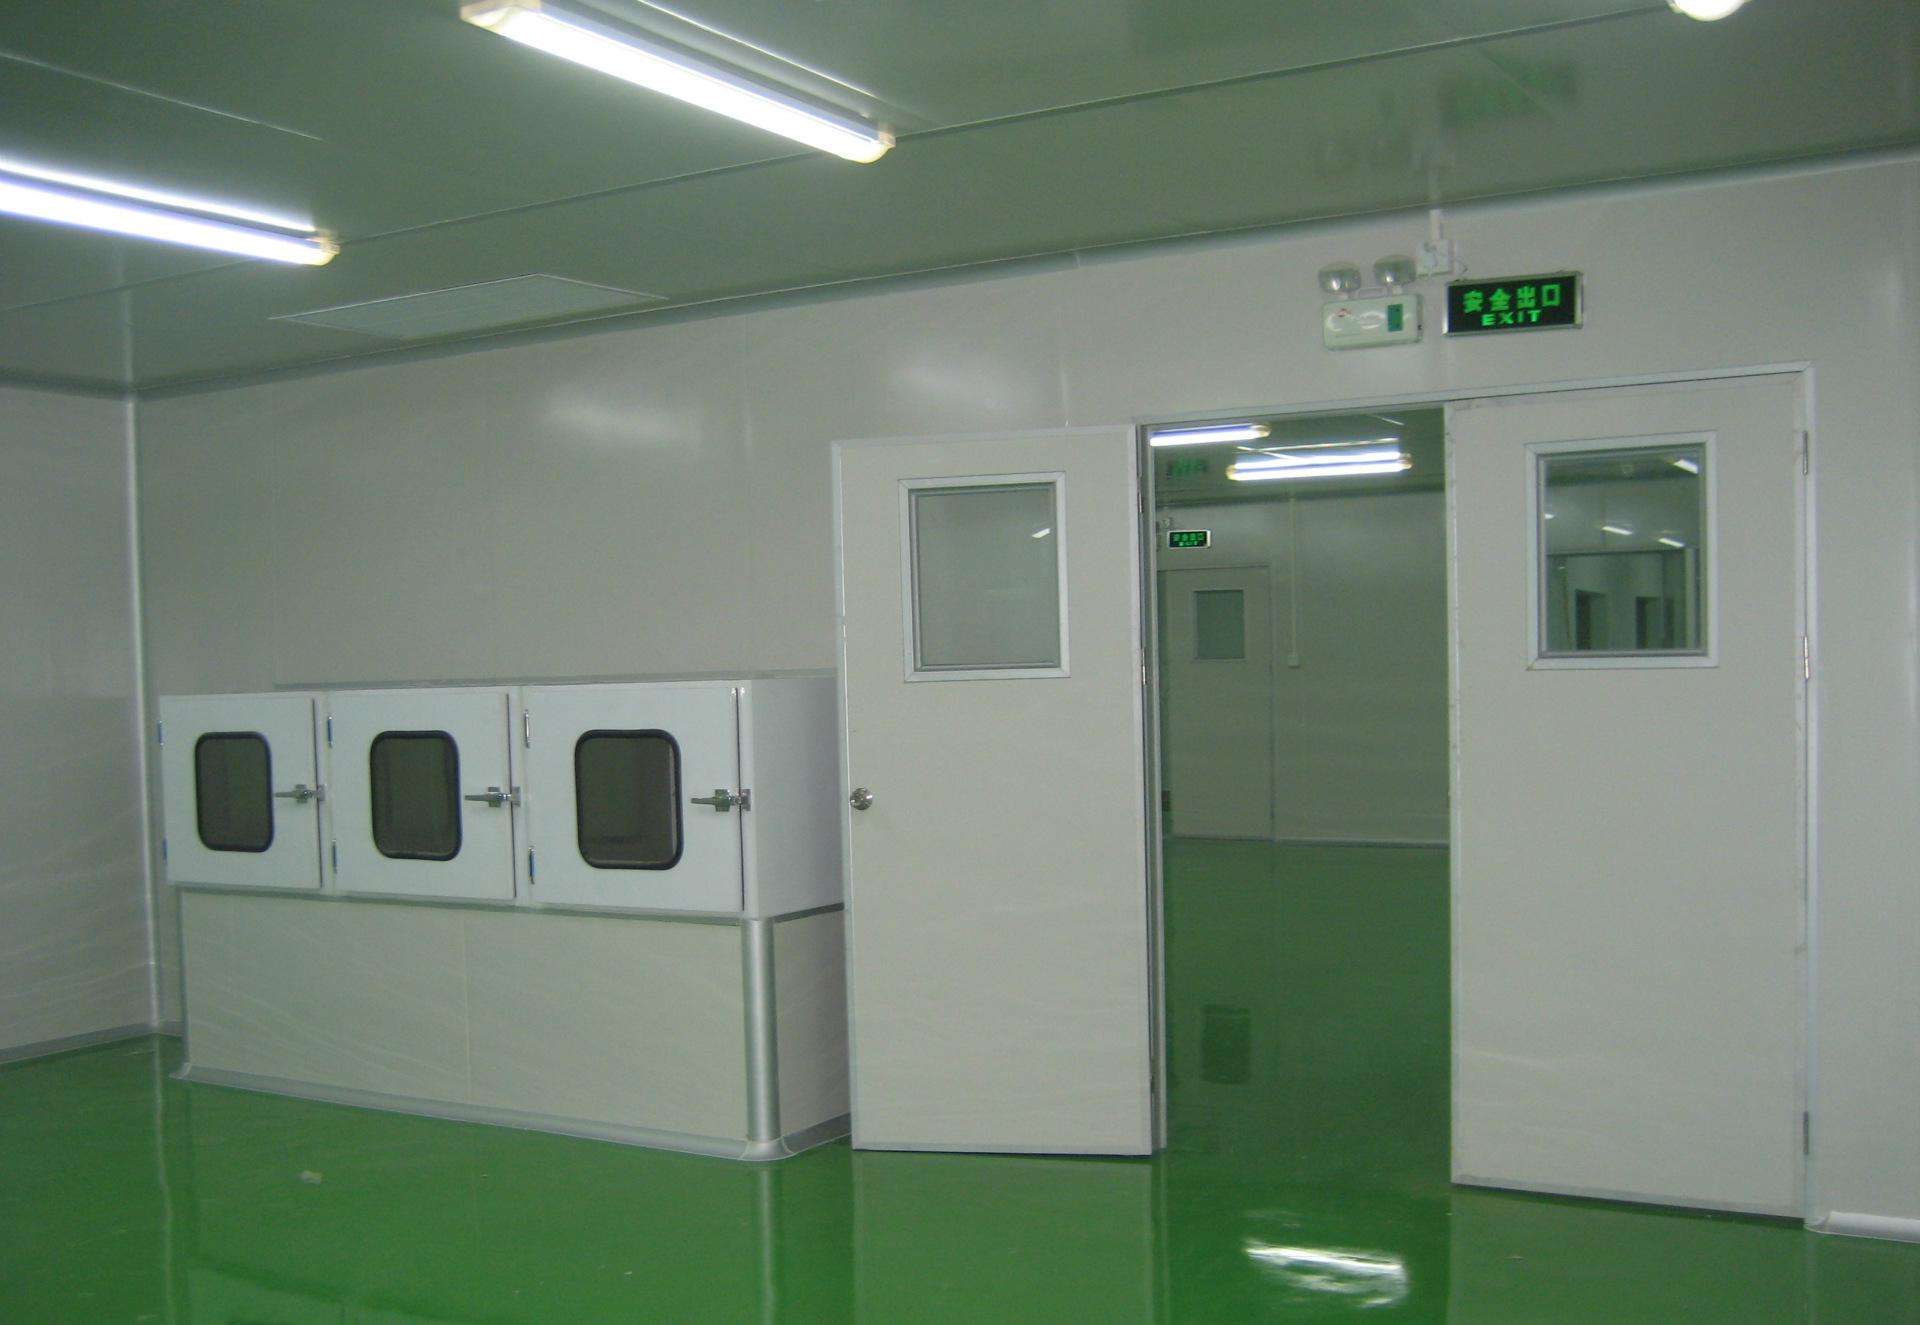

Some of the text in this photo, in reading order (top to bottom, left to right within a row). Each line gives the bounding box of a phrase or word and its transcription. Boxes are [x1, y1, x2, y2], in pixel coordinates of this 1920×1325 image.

[1463, 283, 1561, 313] 安全出口
[1481, 309, 1542, 326] EXIT
